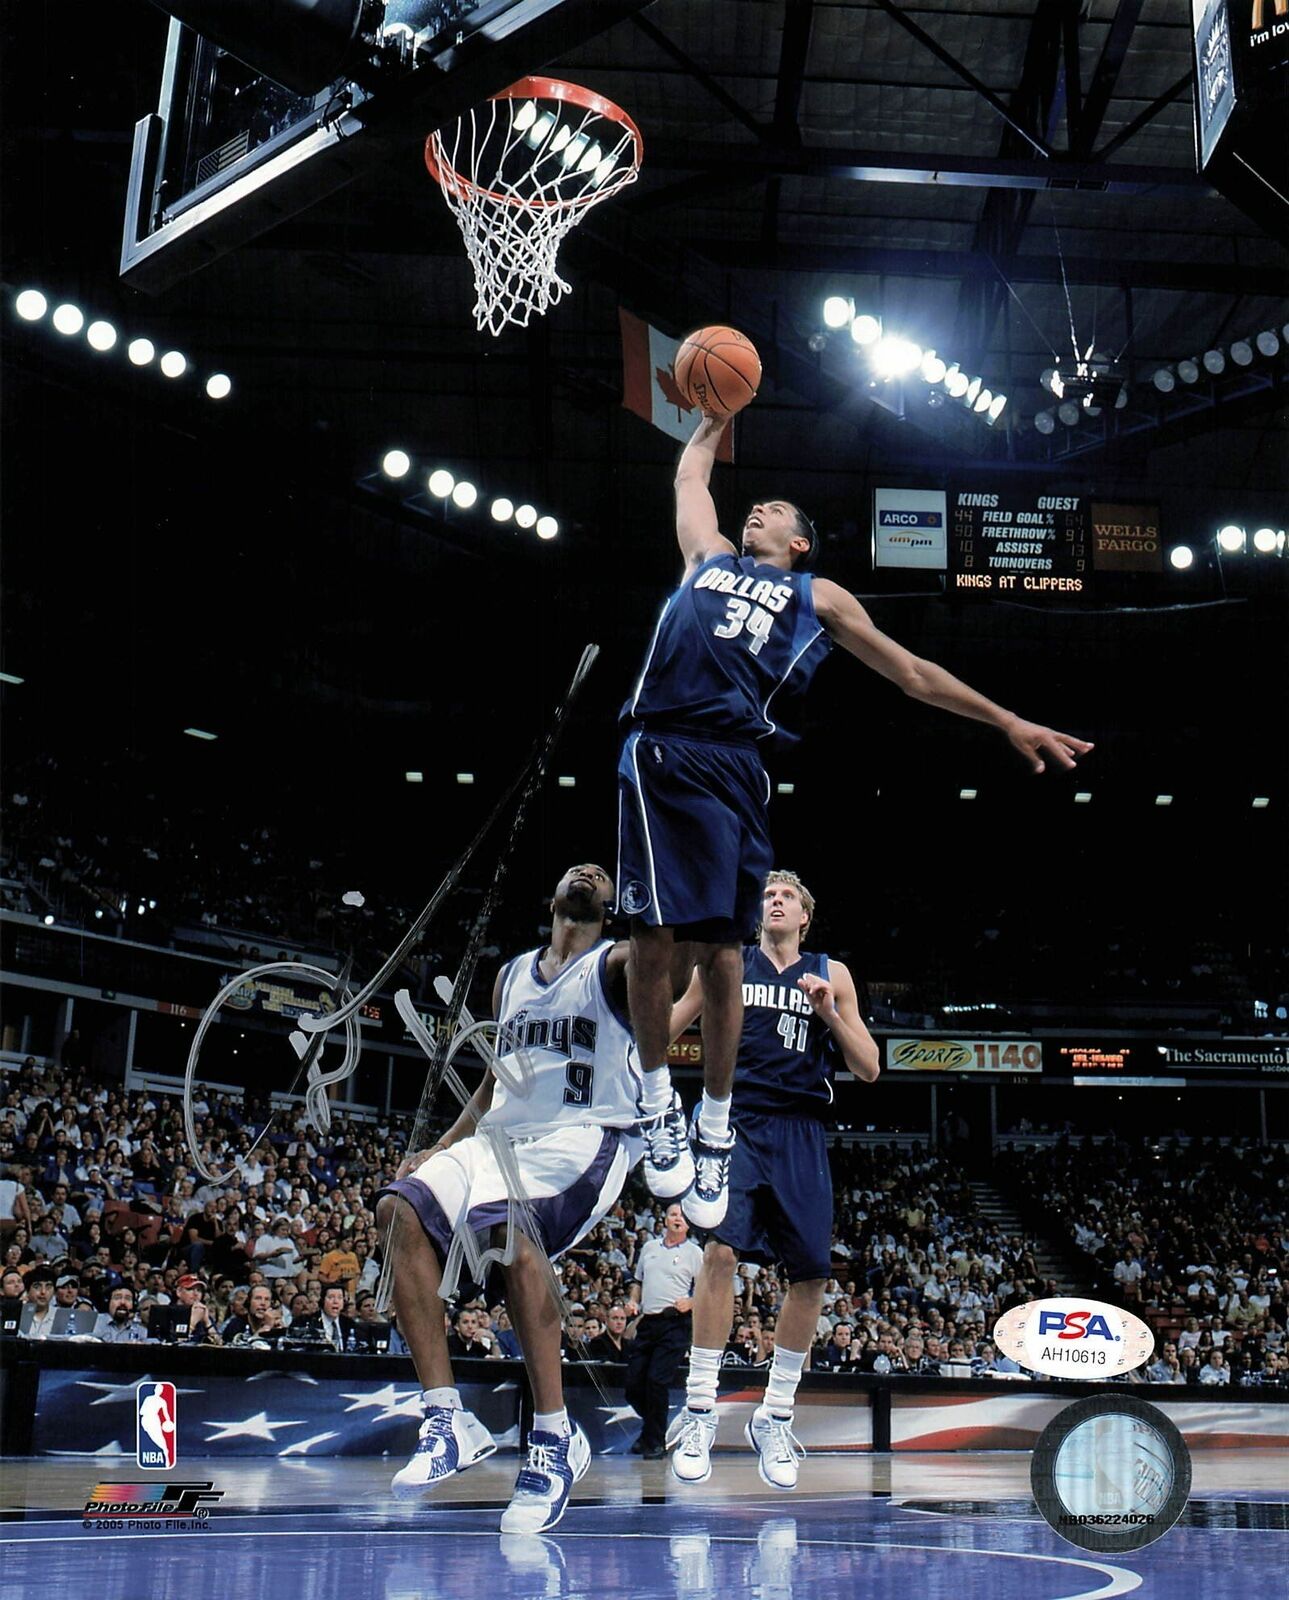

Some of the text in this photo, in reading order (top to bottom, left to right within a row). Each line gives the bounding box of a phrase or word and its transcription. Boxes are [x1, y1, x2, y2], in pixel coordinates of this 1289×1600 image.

[1250, 31, 1269, 47] i'm
[957, 493, 999, 507] KINGS
[1037, 496, 1079, 511] GUEST
[884, 514, 918, 524] ARCO
[954, 509, 973, 522] 44
[982, 511, 1012, 523] FIELD
[1094, 525, 1157, 538] WELLS
[996, 541, 1043, 554] ASSISTS
[1097, 538, 1157, 552] FARGO
[964, 555, 974, 567] 8
[988, 556, 1053, 570] TURNOVERS
[1076, 559, 1085, 572] 9
[693, 567, 794, 613] DALLAS
[956, 574, 1083, 591] KINGS AT CLIPPERS
[713, 597, 775, 657] 34
[742, 983, 813, 1016] DALLAS
[776, 1012, 810, 1053] 41
[667, 1043, 702, 1061] arg
[893, 1043, 1041, 1070] SPORTS 1140
[1163, 1048, 1284, 1064] The Sacramento
[562, 1061, 595, 1109] 9
